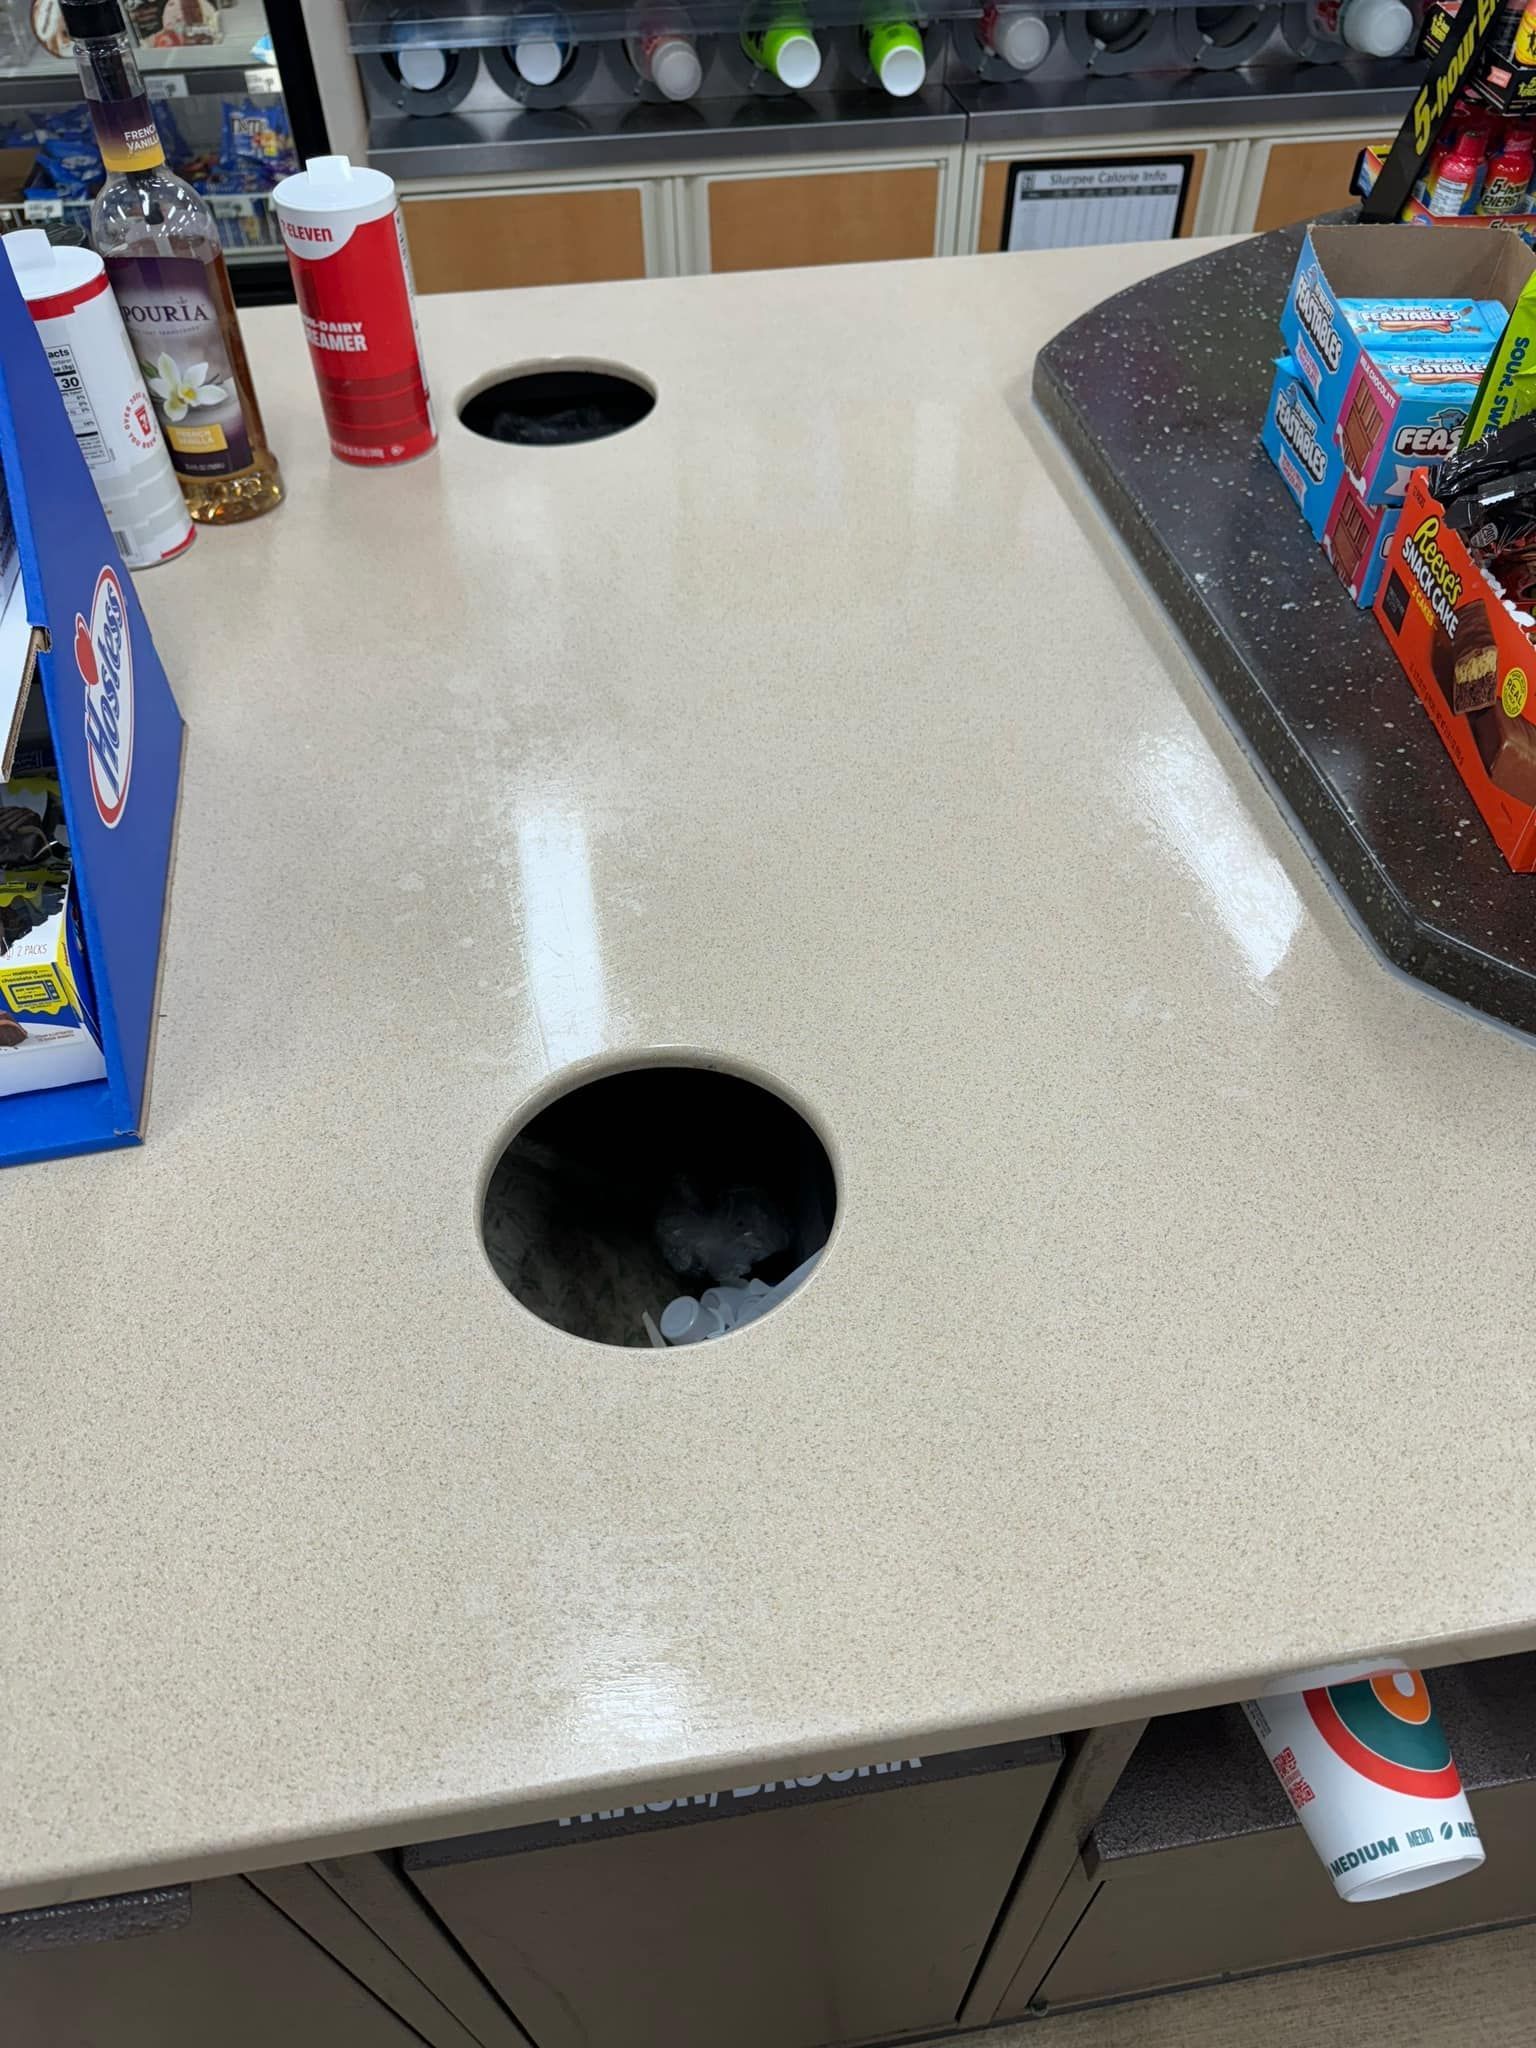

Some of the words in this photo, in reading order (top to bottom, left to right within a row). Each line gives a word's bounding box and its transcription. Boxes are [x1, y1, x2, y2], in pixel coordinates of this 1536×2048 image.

[1414, 14, 1477, 156] 5-hour
[1049, 173, 1094, 187] Slurpee
[1098, 171, 1139, 184] Calorie
[1143, 170, 1168, 182] Info
[1296, 281, 1342, 373] FEASTABLES
[1360, 310, 1460, 321] FEASTABLES
[48, 349, 70, 358] acts
[60, 376, 80, 389] 30
[1368, 369, 1397, 409] CHOCOLATE
[1275, 388, 1327, 485] FEASTABLES
[1413, 517, 1462, 606] Reese's
[1402, 536, 1435, 598] SNACK
[1432, 587, 1459, 640] CAKE
[1415, 592, 1435, 627] CAKES
[86, 582, 124, 801] Hostess
[1507, 678, 1522, 706] REAL
[24, 943, 48, 956] PACKS
[1330, 1836, 1400, 1878] MEDIUM
[1405, 1827, 1435, 1849] MEDIO
